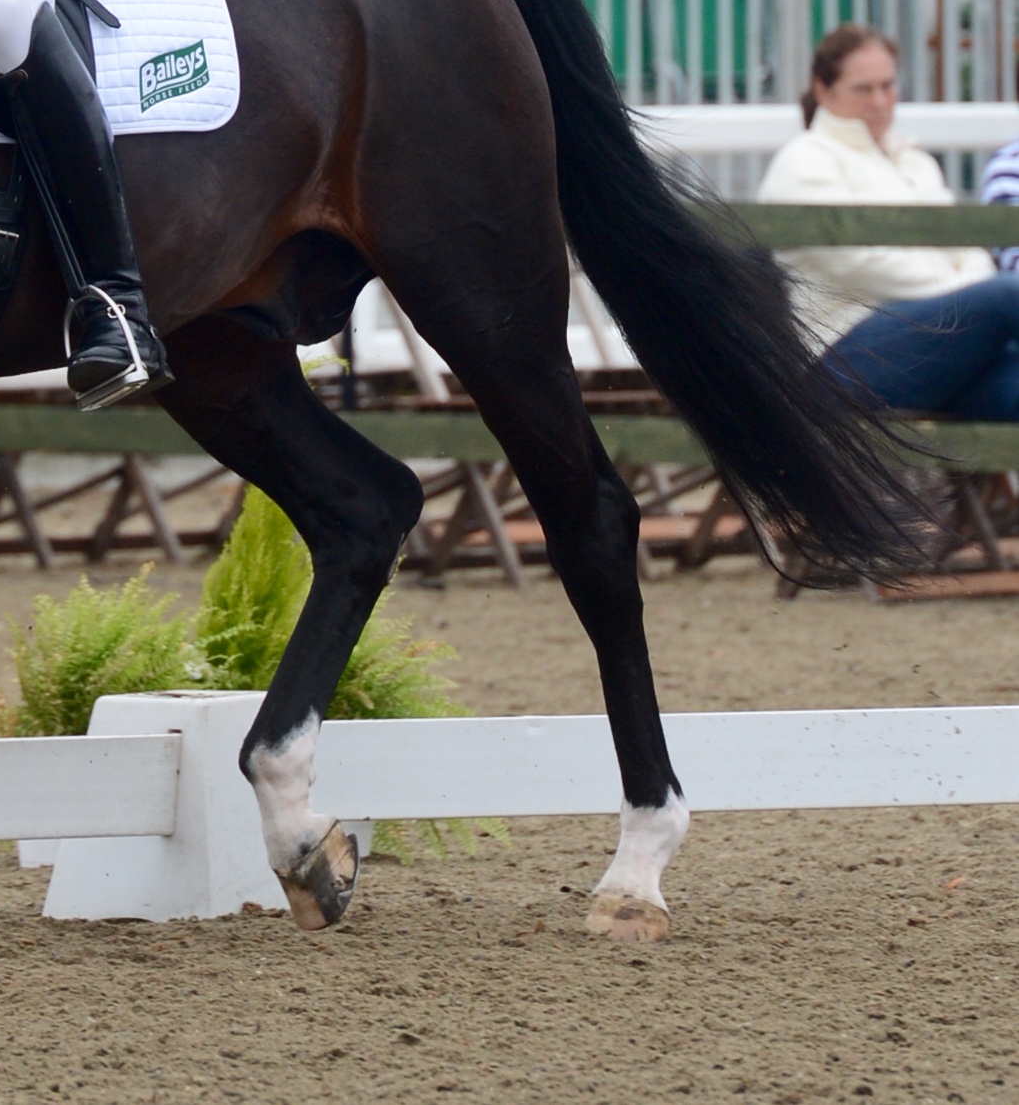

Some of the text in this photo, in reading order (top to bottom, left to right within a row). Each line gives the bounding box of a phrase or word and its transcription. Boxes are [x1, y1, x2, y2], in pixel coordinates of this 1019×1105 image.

[141, 46, 205, 97] Baileys
[143, 75, 208, 109] HORSE FEEDS
